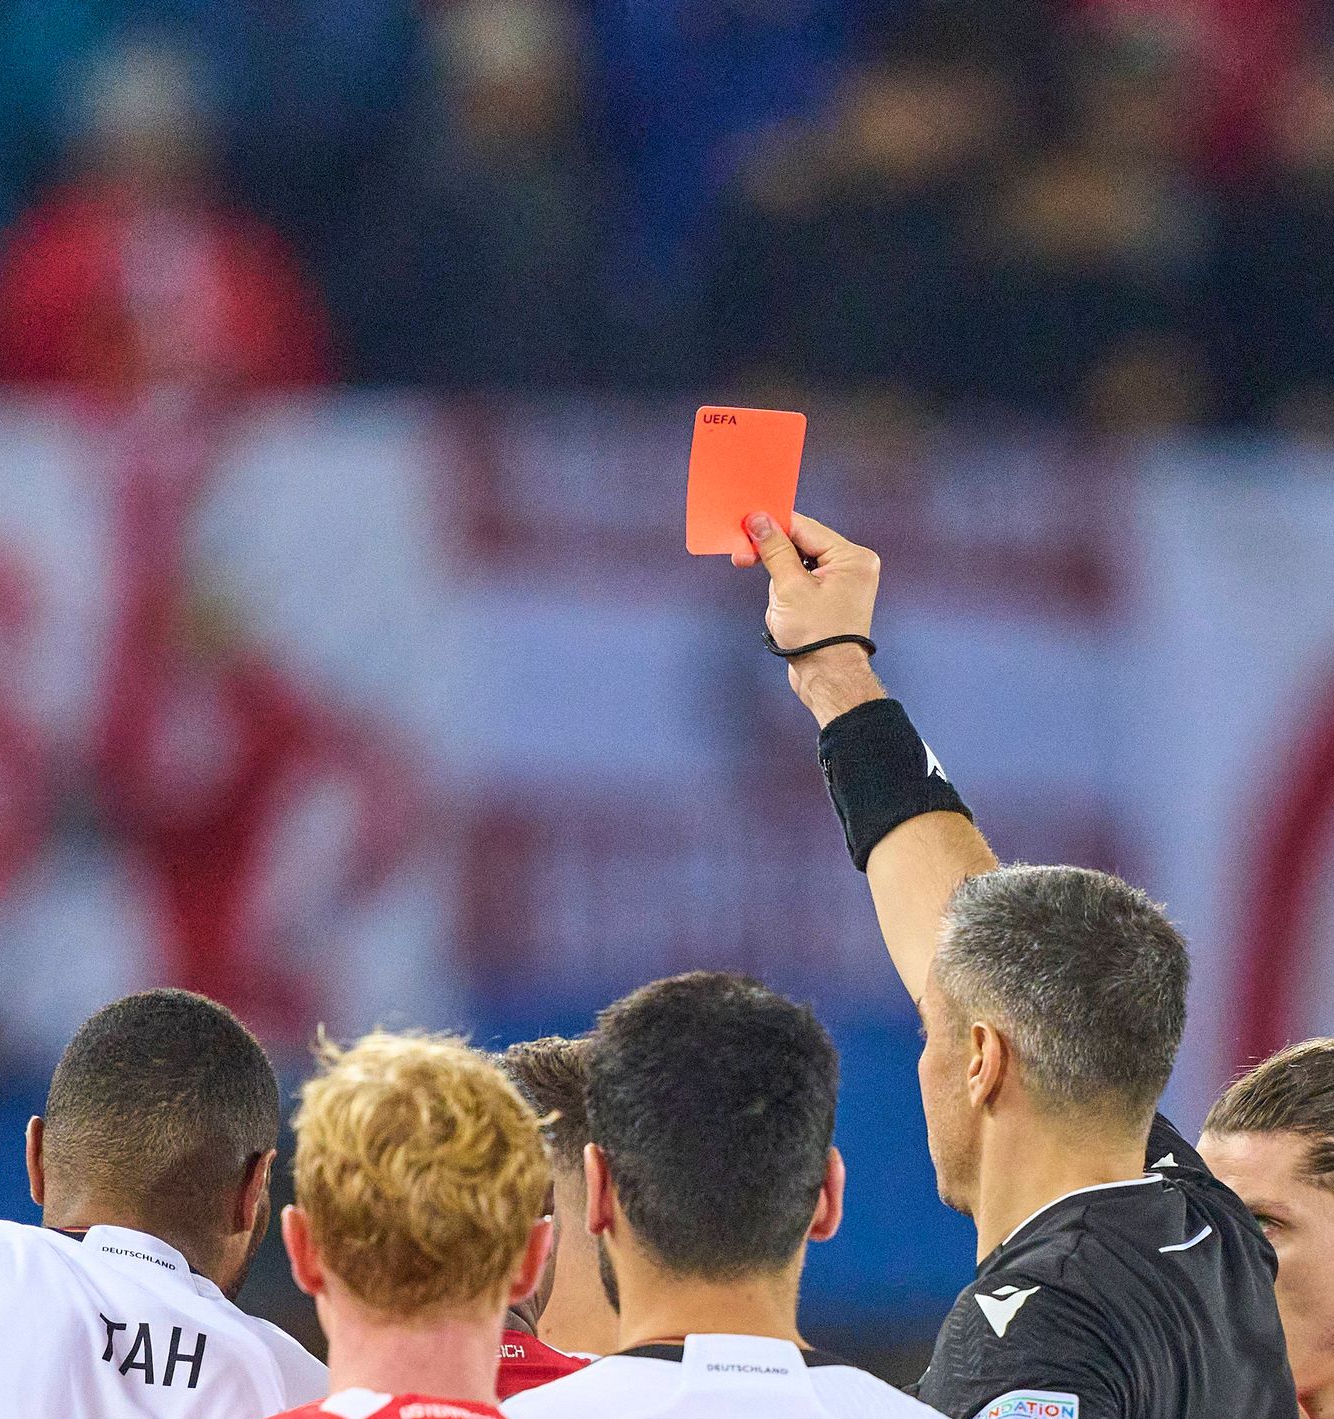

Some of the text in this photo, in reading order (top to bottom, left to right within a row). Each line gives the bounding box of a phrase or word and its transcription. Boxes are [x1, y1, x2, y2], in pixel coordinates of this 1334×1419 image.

[702, 414, 737, 425] UEFA
[101, 1245, 176, 1271] DEUTSCHLAND
[99, 1312, 207, 1389] TAH
